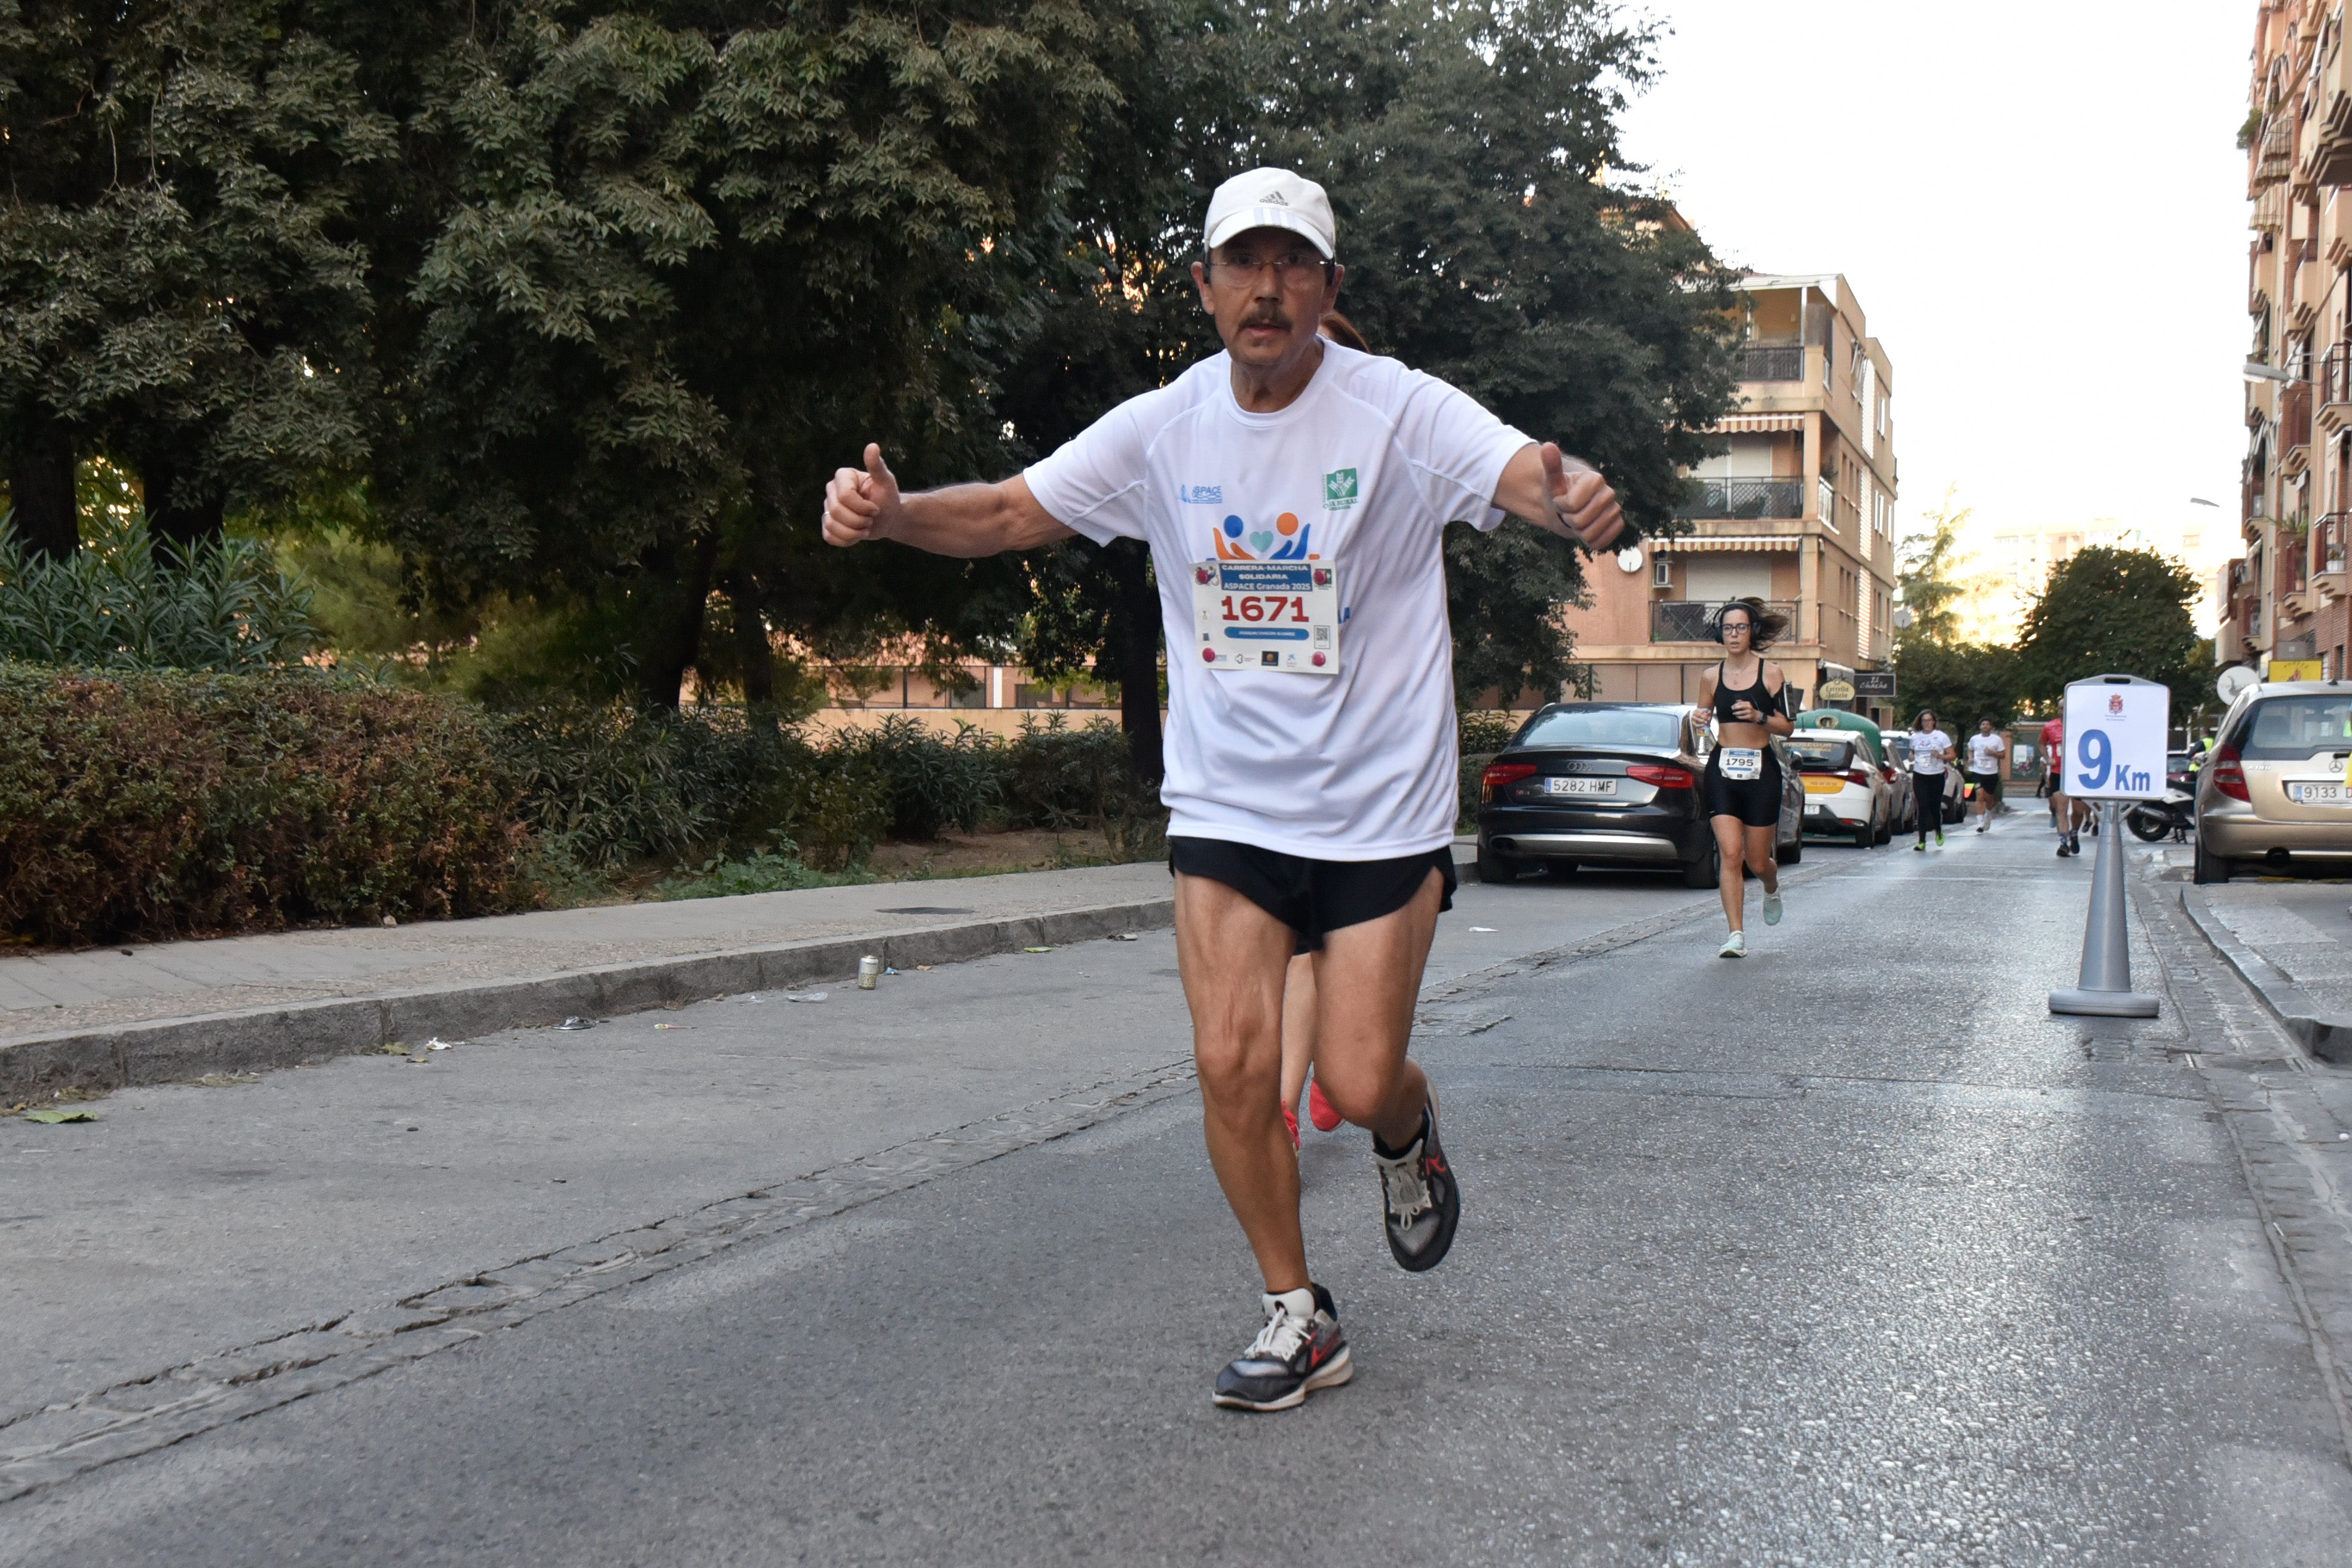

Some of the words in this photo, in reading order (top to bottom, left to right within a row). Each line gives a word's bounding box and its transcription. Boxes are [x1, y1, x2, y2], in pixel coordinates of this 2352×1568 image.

[1221, 595, 1309, 622] 1671
[1726, 758, 1754, 767] 1795
[2078, 728, 2112, 789] 9
[2115, 764, 2150, 791] Km
[1554, 780, 1585, 792] 5282
[1590, 781, 1613, 792] HMF
[2304, 786, 2337, 798] 9133
